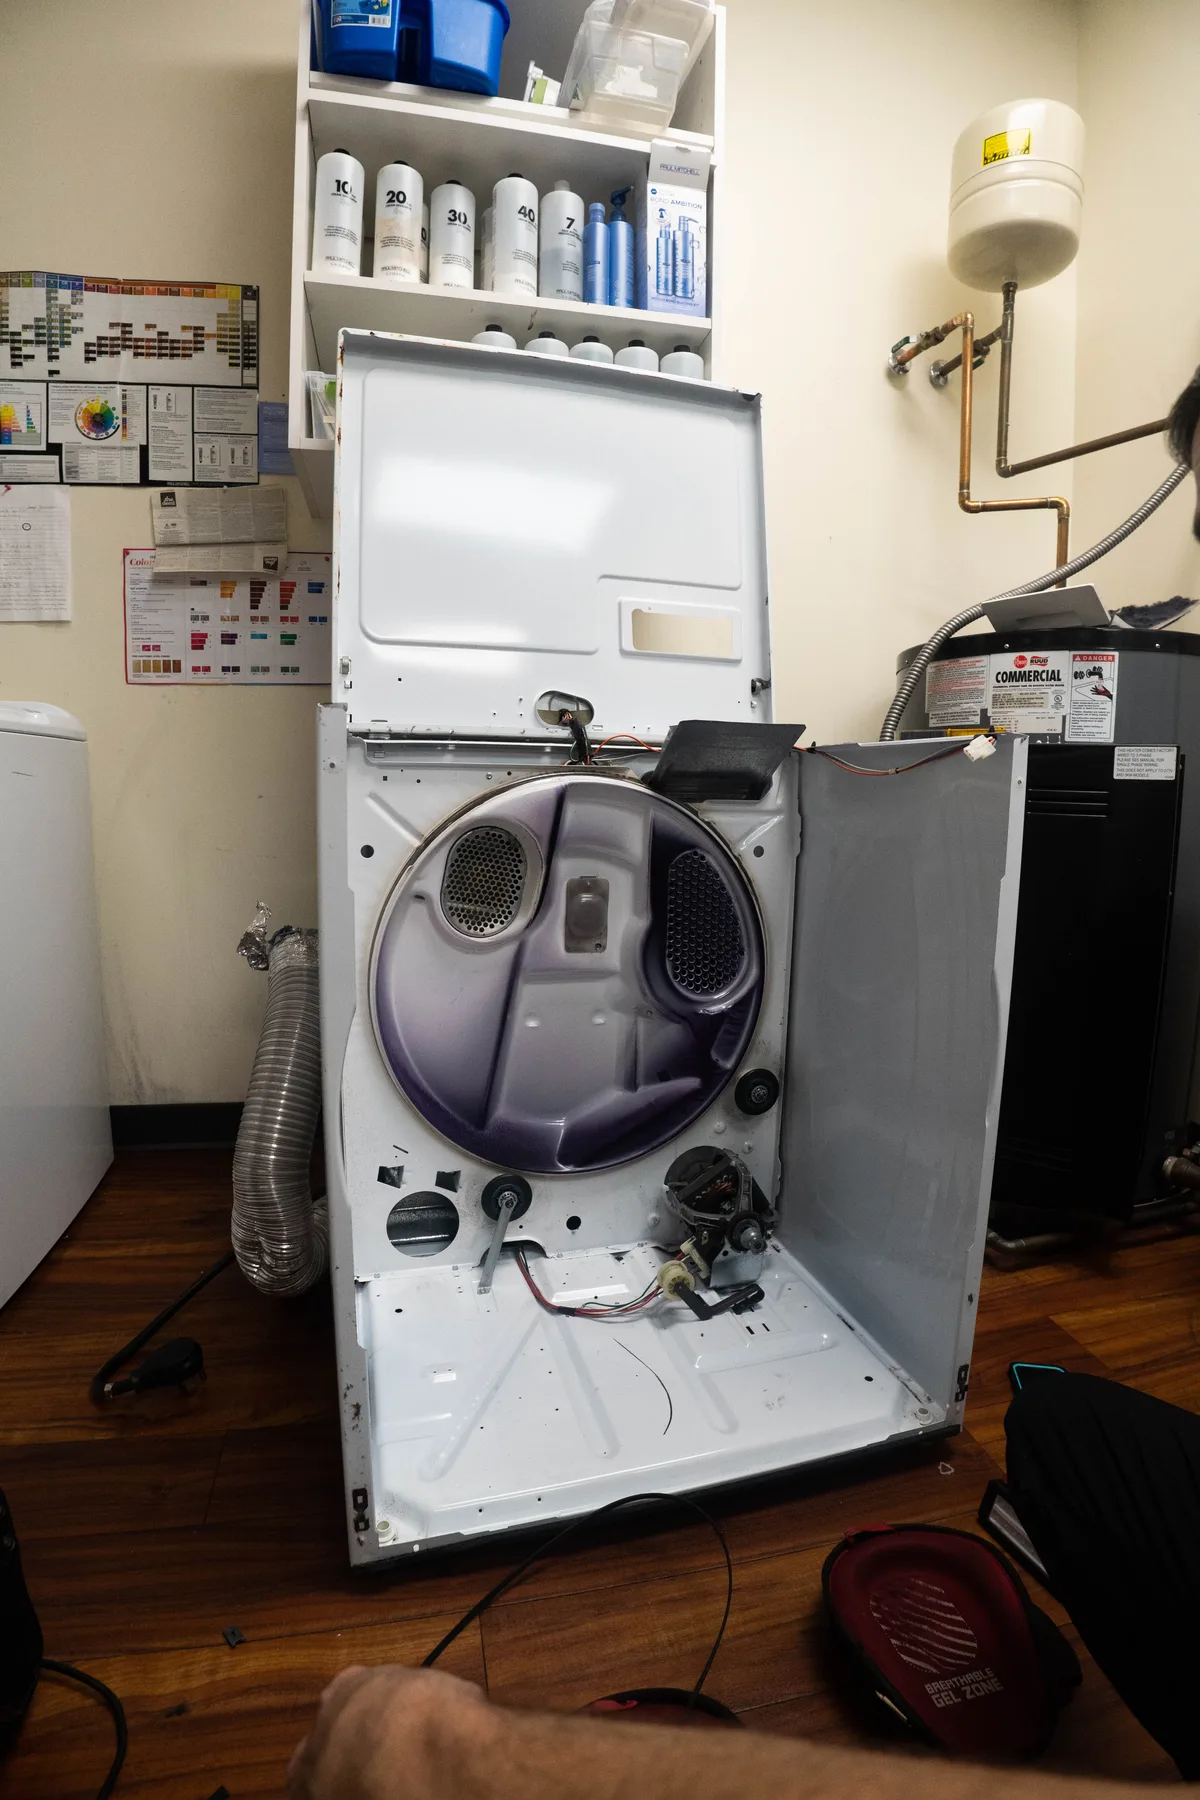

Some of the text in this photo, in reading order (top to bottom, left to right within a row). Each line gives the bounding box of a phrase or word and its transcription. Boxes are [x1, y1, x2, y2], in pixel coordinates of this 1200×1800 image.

[335, 179, 352, 195] 10
[386, 190, 407, 204] 20
[650, 196, 703, 210] BOND AMBITION
[447, 209, 467, 225] 30
[518, 205, 535, 222] 40
[566, 217, 576, 229] 7
[995, 669, 1062, 684] COMMERCIAL
[924, 1667, 995, 1695] BREATHABLE
[930, 1678, 1004, 1709] GEL ZONE
